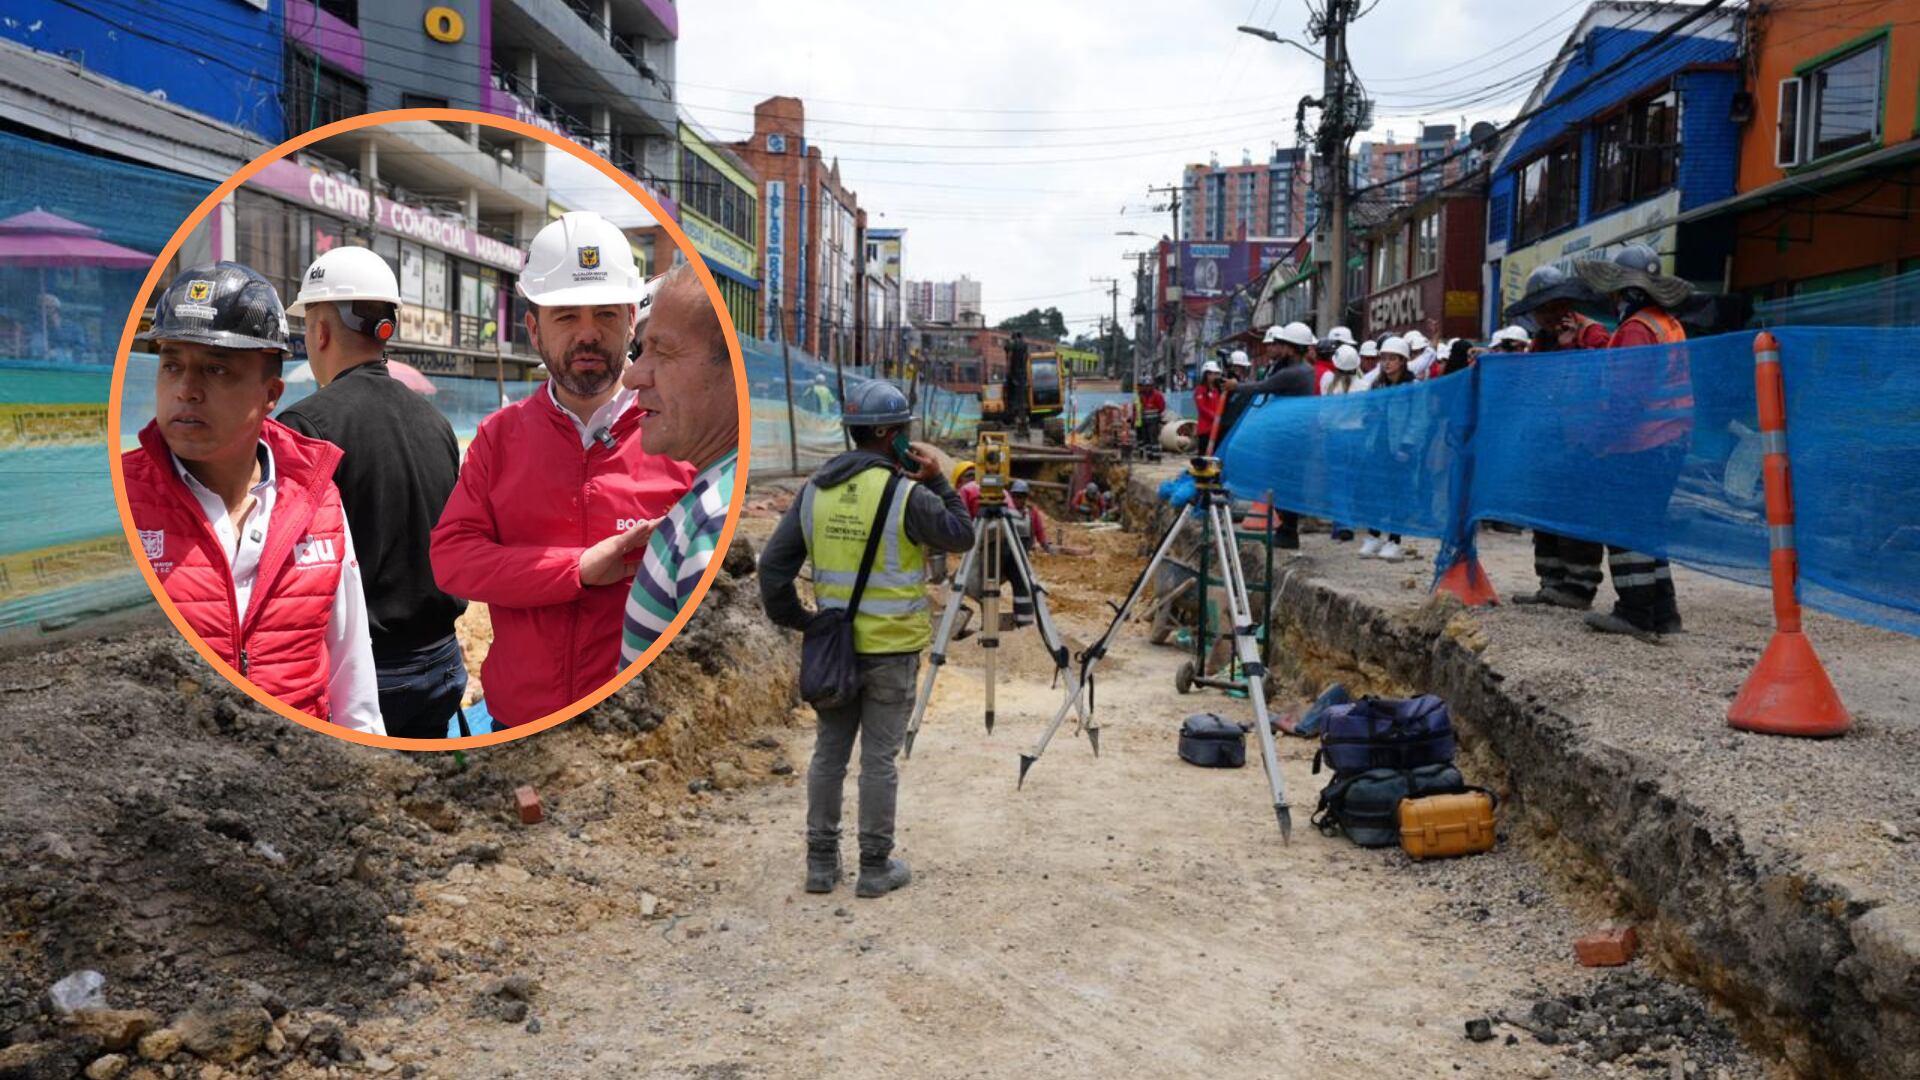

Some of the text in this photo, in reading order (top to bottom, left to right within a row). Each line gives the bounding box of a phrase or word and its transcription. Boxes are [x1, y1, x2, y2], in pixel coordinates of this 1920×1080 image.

[310, 173, 383, 222] CENTRO
[390, 203, 469, 253] COMERCIAL
[309, 266, 325, 280] idu
